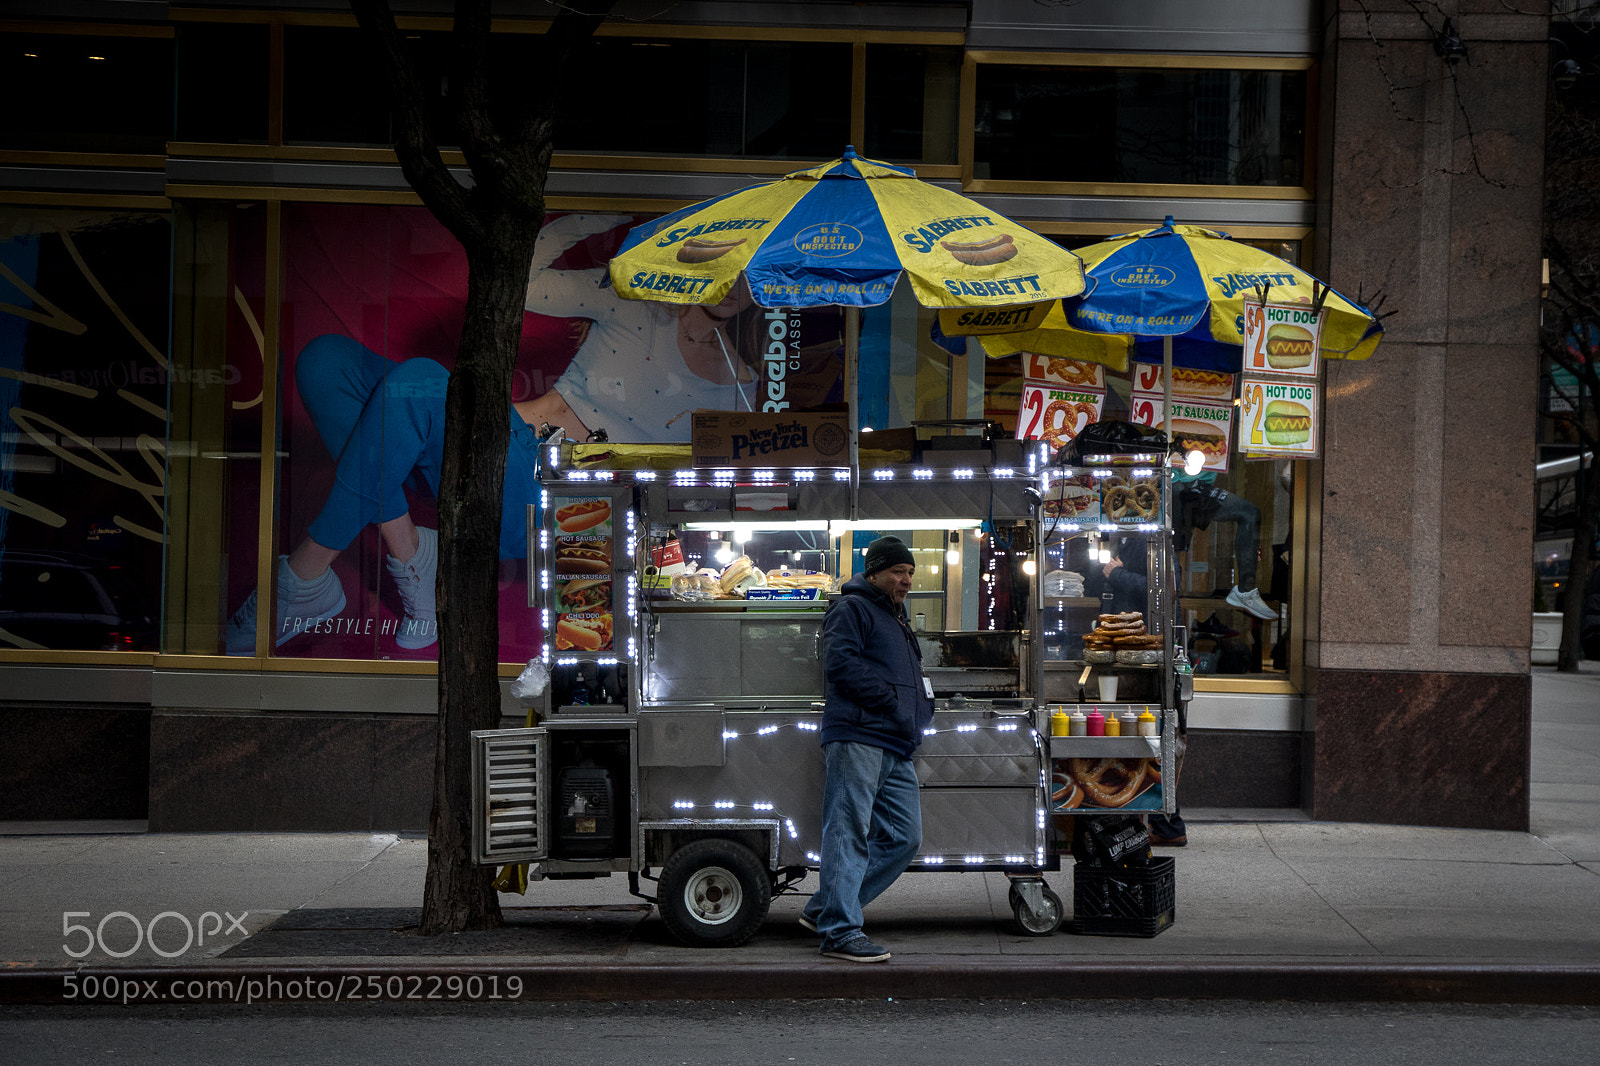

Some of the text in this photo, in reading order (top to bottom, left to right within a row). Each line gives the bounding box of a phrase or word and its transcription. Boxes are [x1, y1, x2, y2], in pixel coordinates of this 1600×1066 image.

[656, 217, 771, 247] SABRETT
[899, 214, 996, 253] SABRETT
[629, 269, 715, 294] SABRETT
[763, 284, 802, 295] WE'RE
[804, 284, 823, 295] ON
[825, 285, 834, 294] A
[837, 284, 868, 295] ROLL
[942, 272, 1041, 297] SABRETT
[1208, 271, 1300, 298] SABRETT
[958, 306, 1035, 326] SABRETT
[1076, 308, 1114, 323] WE'RE
[1116, 315, 1134, 325] ON
[1135, 316, 1144, 325] A
[1147, 316, 1176, 326] ROLL
[1268, 308, 1319, 325] HOT DOG
[789, 307, 801, 371] CLASSI
[1247, 306, 1266, 368] $2
[1049, 390, 1099, 404] PRETZEL
[1266, 385, 1313, 400] HOT DOG
[1184, 406, 1230, 421] SAUSAGE
[1244, 384, 1264, 445] $2
[749, 420, 802, 441] New York
[731, 426, 809, 459] Pretzel
[282, 616, 374, 635] FREESTYLE
[381, 618, 399, 636] HI
